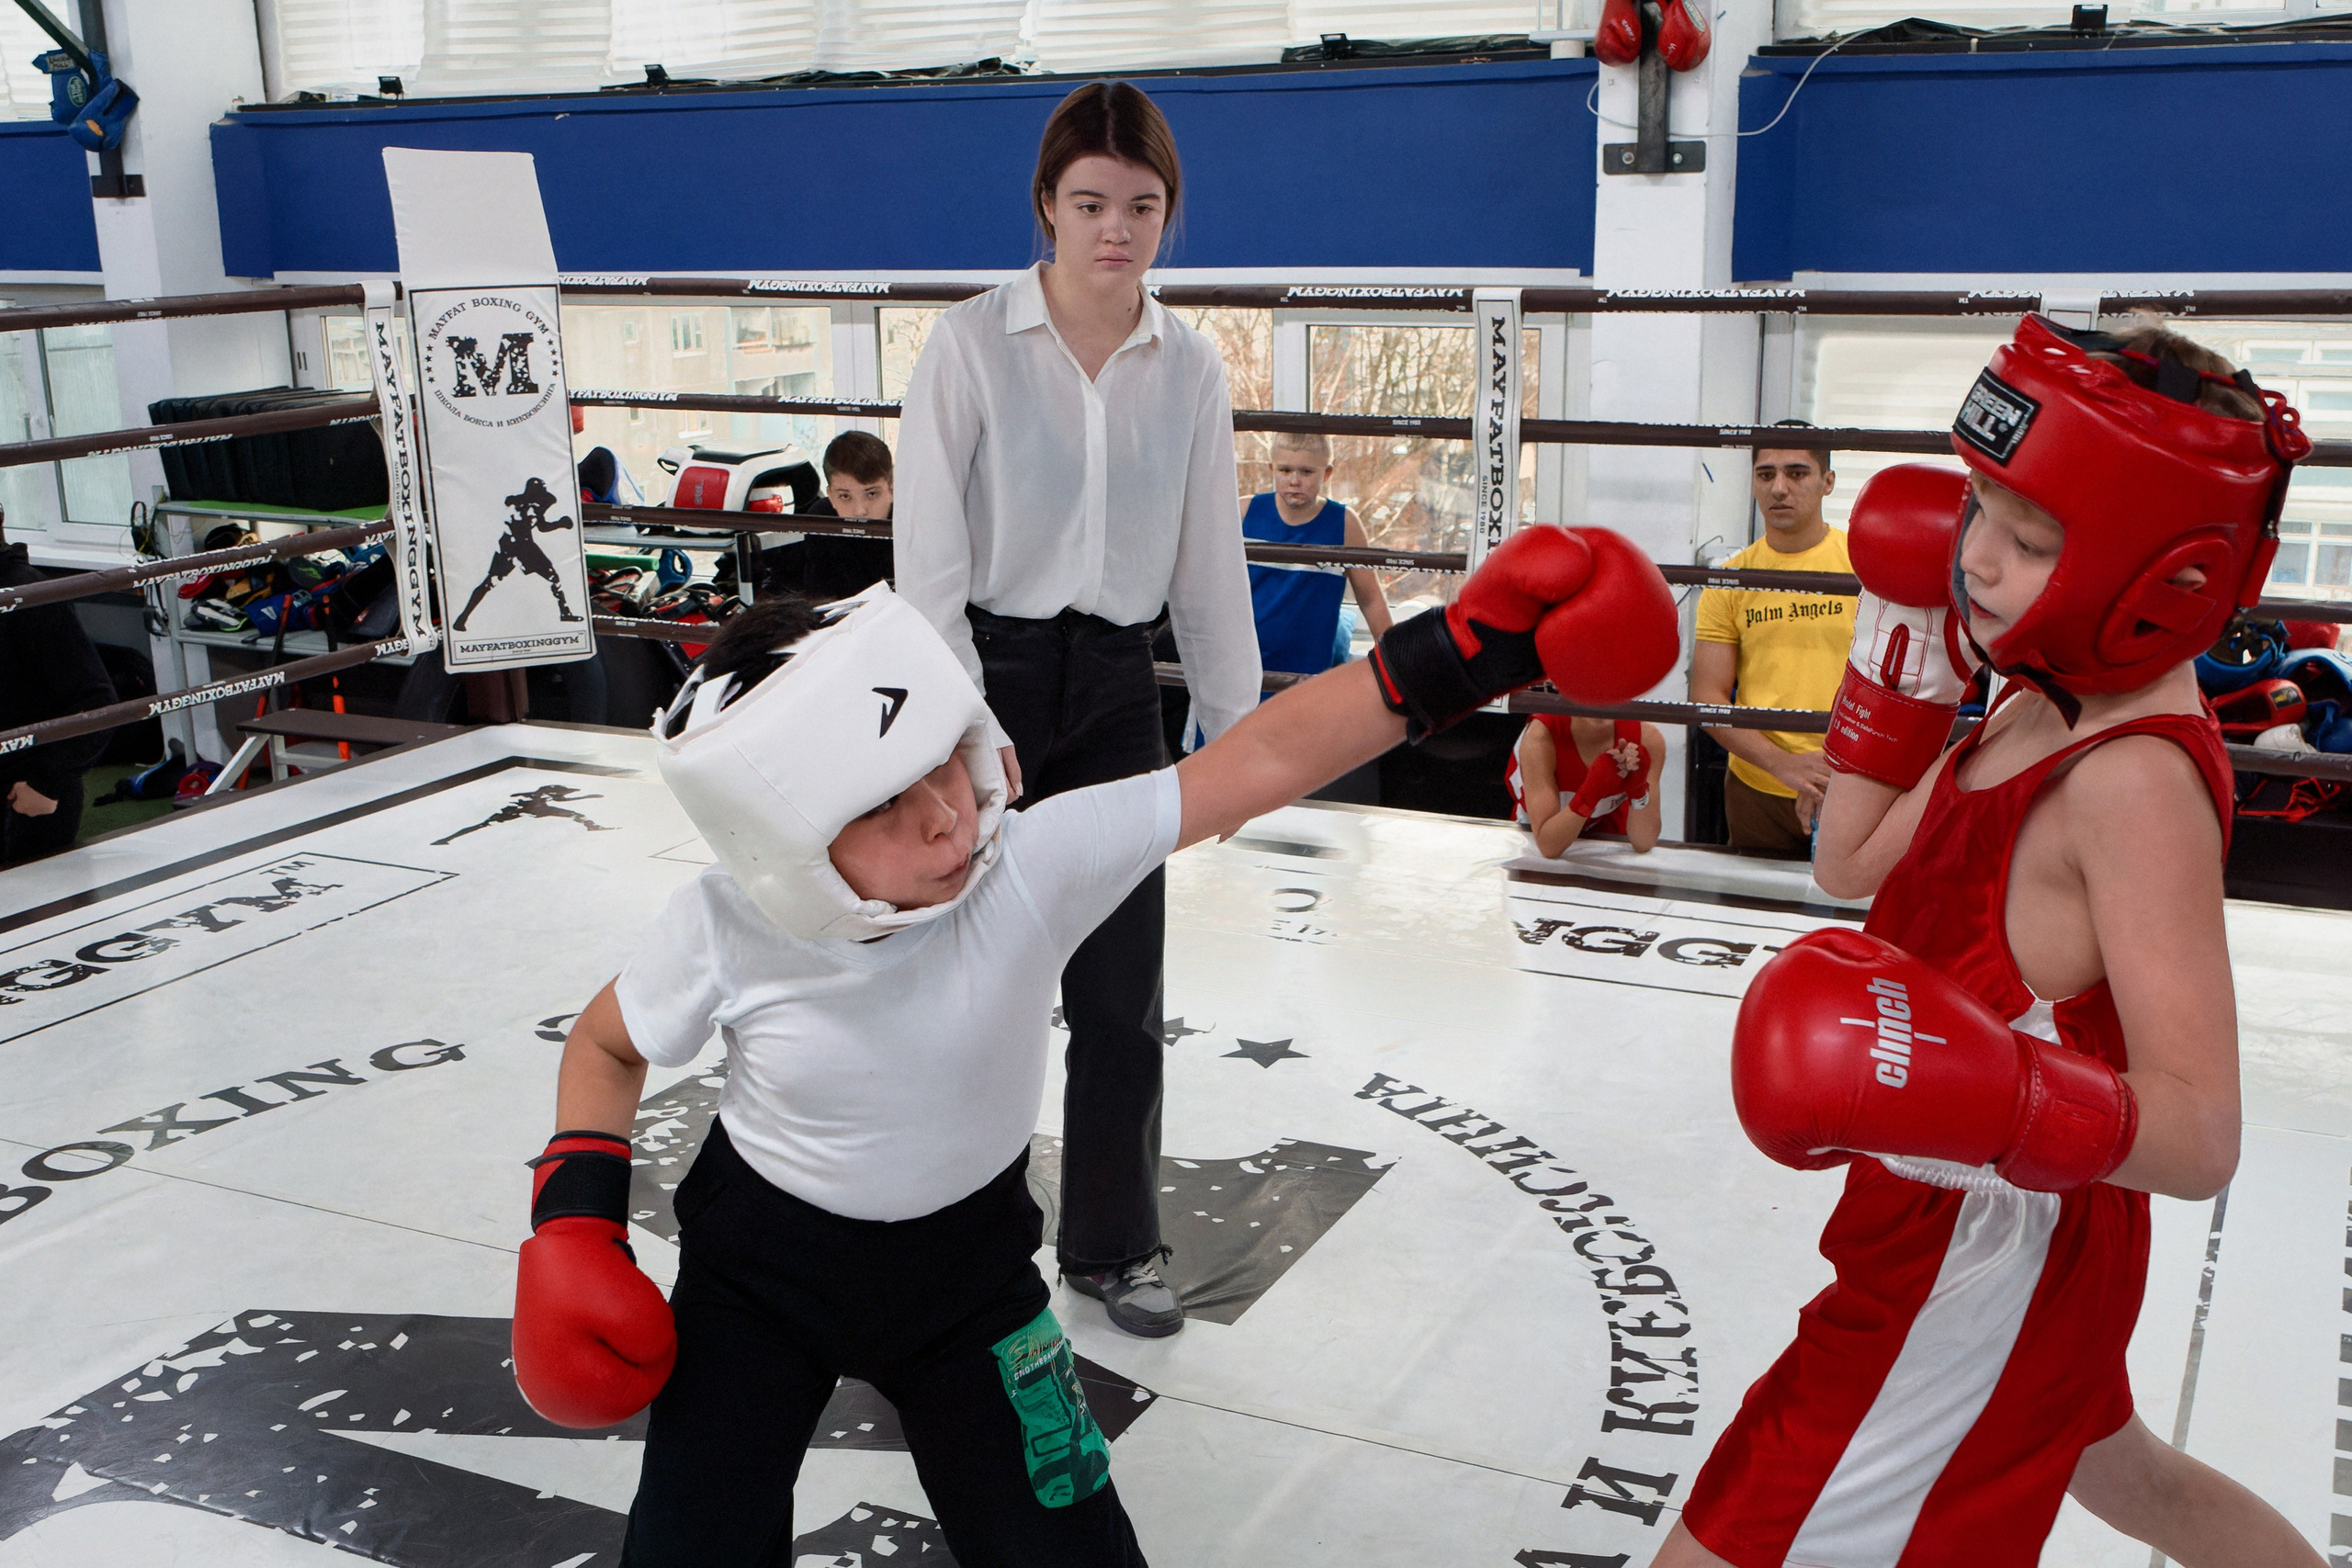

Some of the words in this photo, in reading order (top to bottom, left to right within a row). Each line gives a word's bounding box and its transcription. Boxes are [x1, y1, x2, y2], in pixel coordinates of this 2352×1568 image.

[1287, 287, 1464, 298] MAYFATBOXINGGYM
[428, 302, 467, 340] MAYFAT
[471, 297, 522, 312] BOXING
[526, 310, 548, 334] GYM
[446, 333, 539, 398] M
[435, 389, 461, 417] ШКОЛА
[463, 414, 493, 427] БОКСА
[568, 389, 679, 401] YFATBOXINGGYM
[1487, 317, 1507, 555] MAYFATBOXI
[375, 321, 426, 637] MAYFATBOXINGGYM
[1746, 606, 1782, 628] Palm
[1788, 600, 1843, 622] Angels
[460, 636, 579, 653] MAYFATBOXINGGYM
[148, 671, 286, 716] MAYFATBOXINGGYM
[0, 876, 345, 1005] GGYM
[1866, 976, 1914, 1089] clinch
